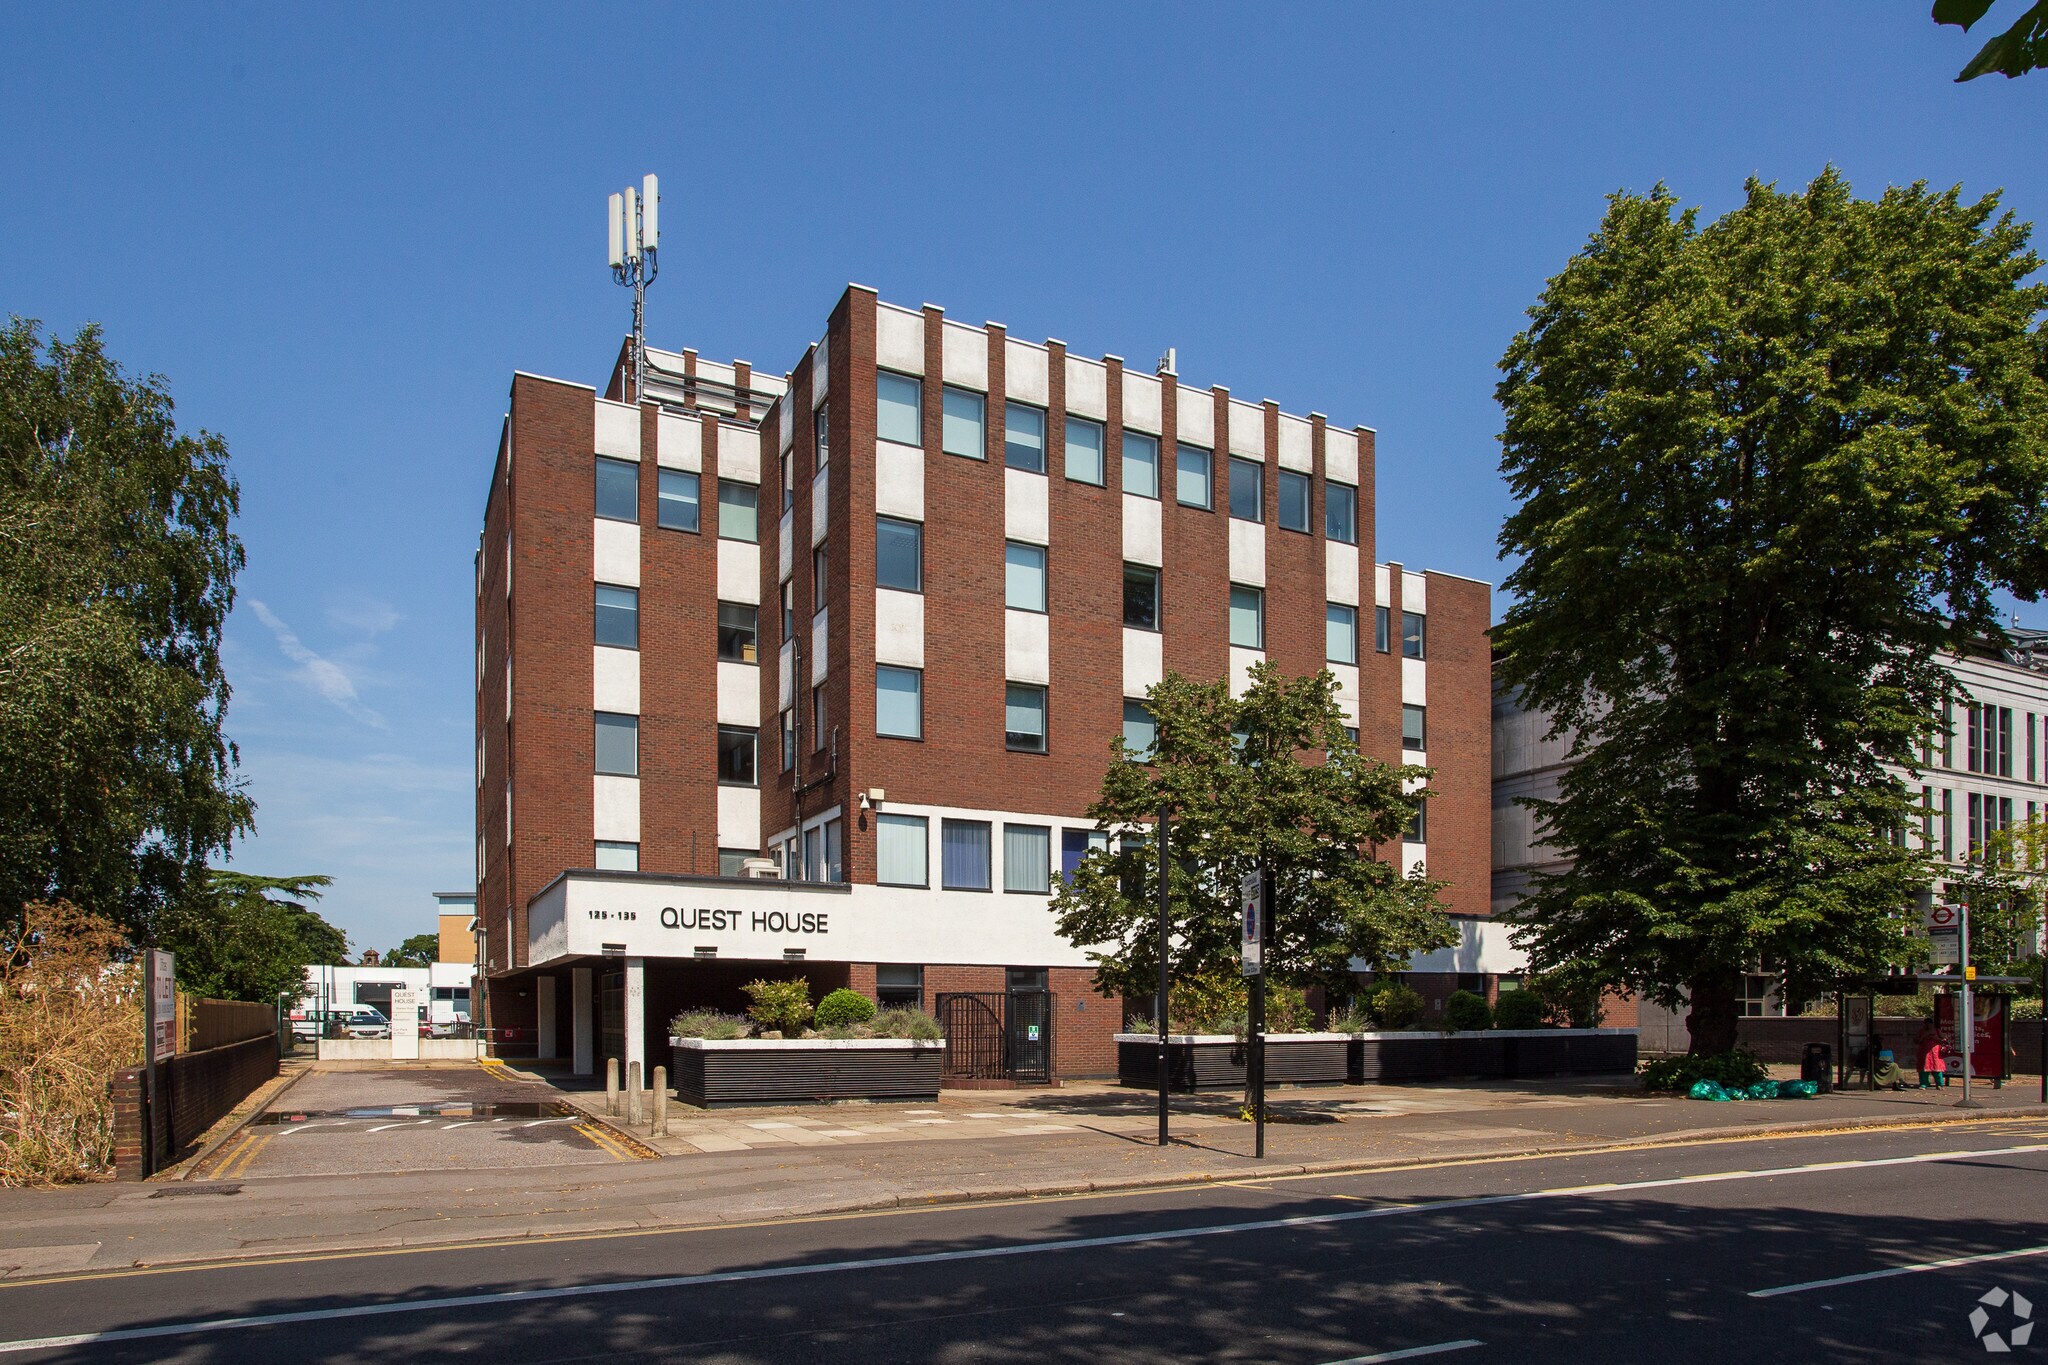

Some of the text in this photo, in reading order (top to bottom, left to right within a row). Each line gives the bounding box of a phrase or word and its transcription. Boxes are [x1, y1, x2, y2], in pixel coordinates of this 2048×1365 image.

[588, 910, 608, 920] 125
[618, 911, 636, 921] 135
[660, 906, 829, 934] QUEST HOUSE
